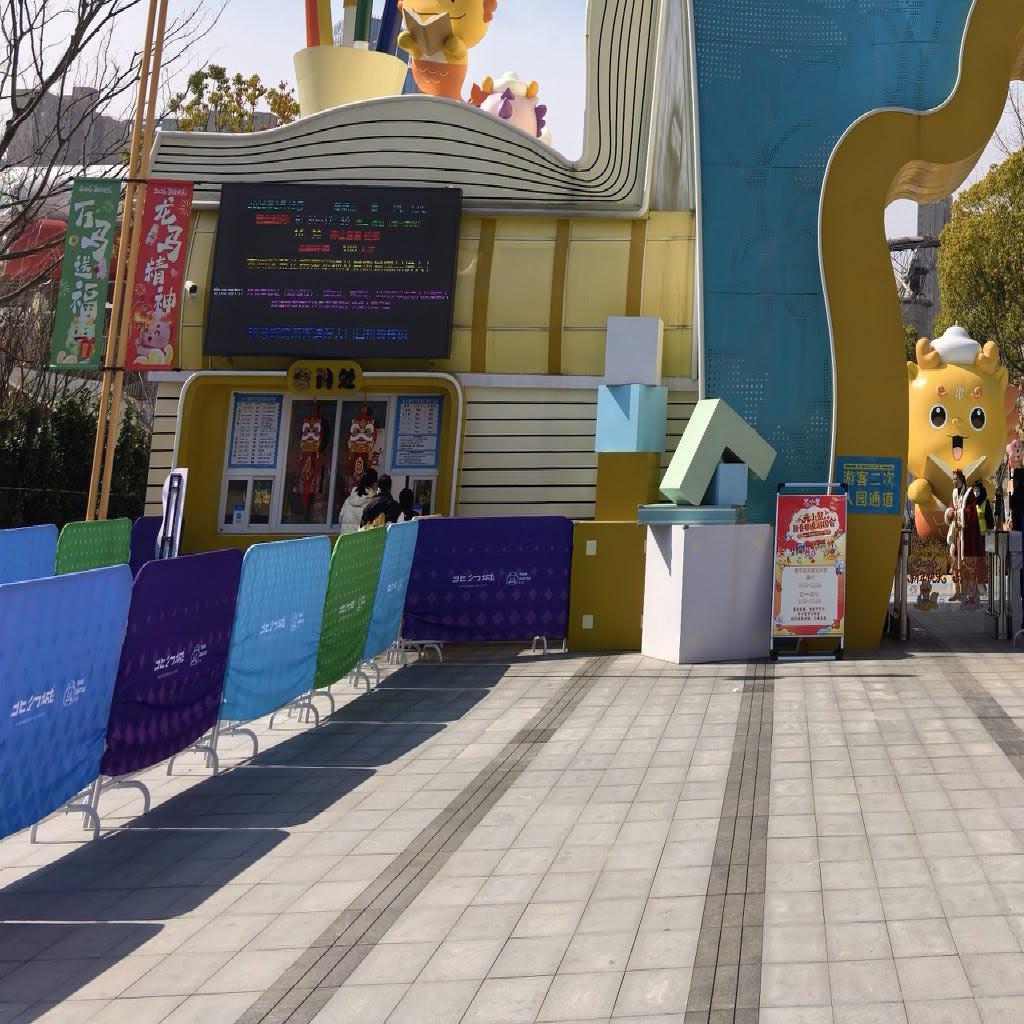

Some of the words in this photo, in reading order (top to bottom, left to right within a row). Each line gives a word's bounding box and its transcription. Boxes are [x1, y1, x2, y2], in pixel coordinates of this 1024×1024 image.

[69, 199, 112, 320] 万马送福
[144, 196, 184, 317] 龙马精神
[843, 469, 895, 487] 游客二次
